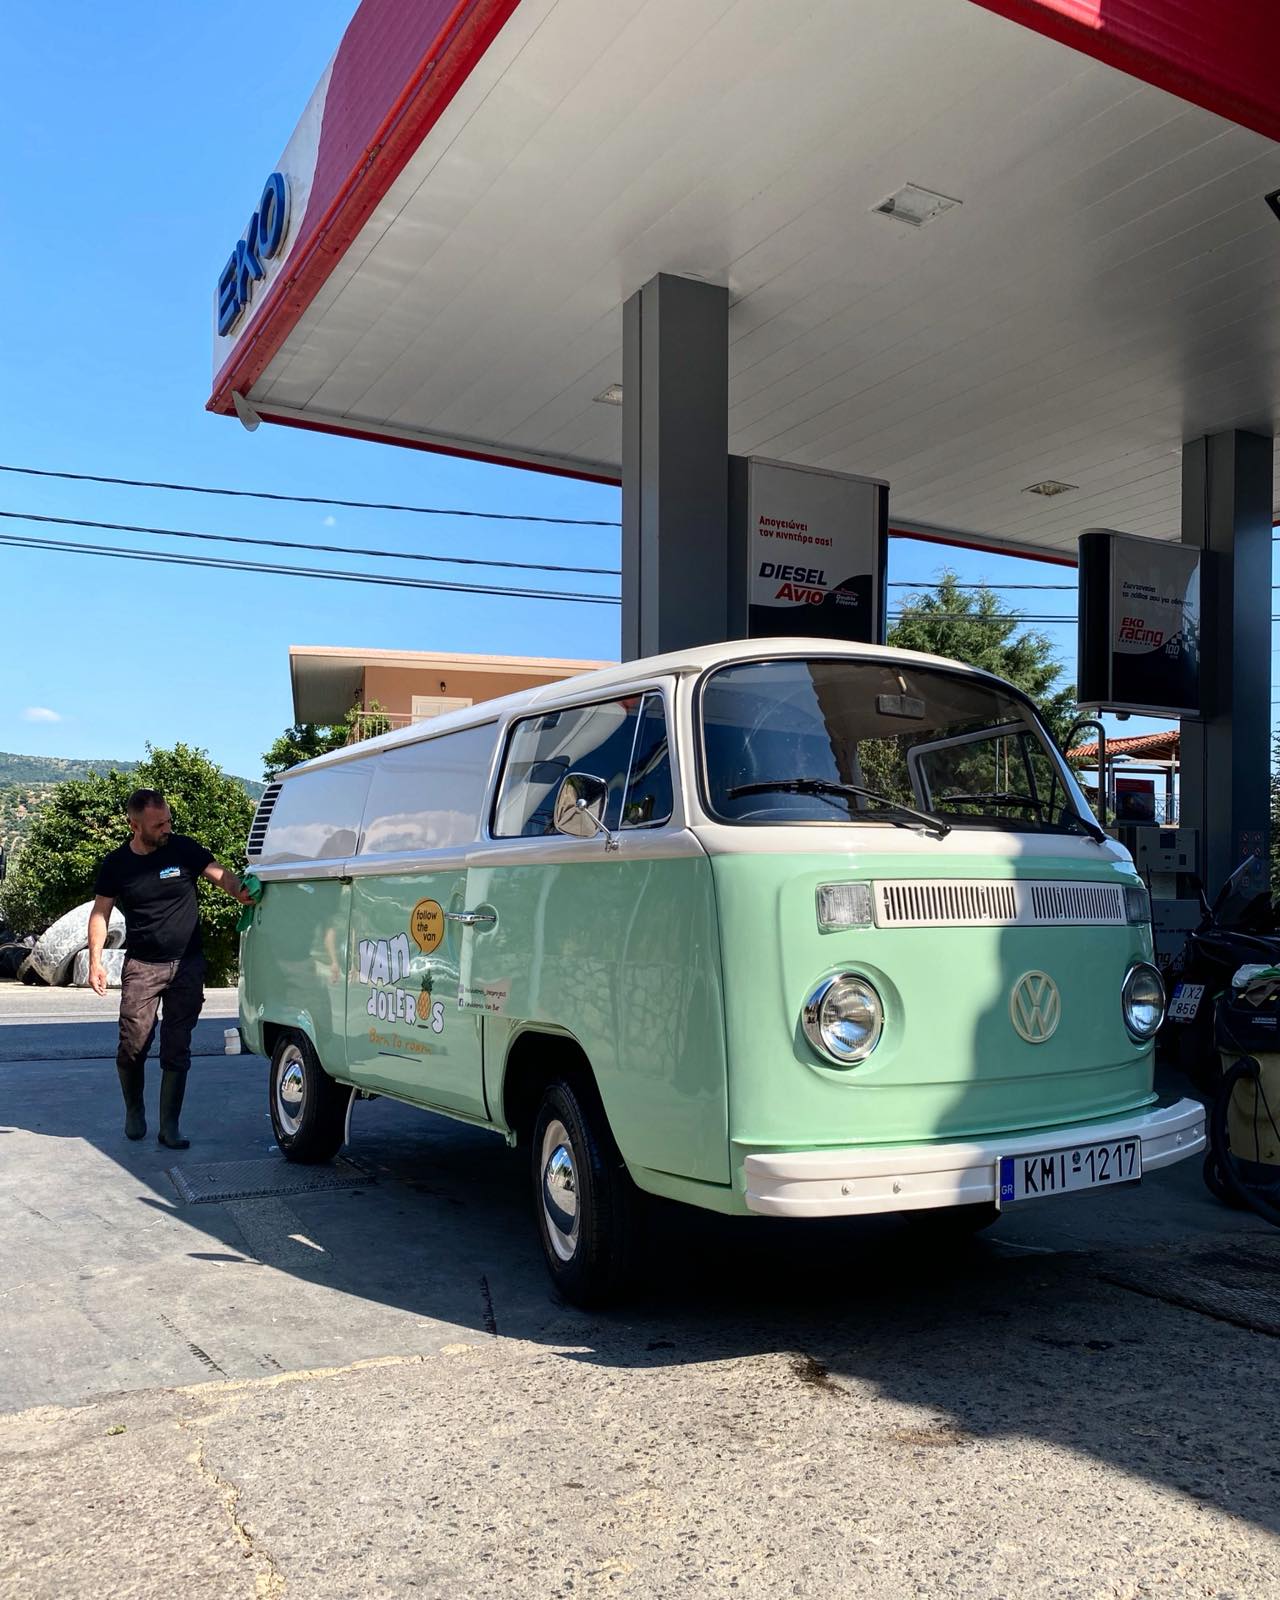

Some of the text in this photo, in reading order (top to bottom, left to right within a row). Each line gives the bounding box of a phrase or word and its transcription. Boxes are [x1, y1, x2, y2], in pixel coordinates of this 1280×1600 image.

[218, 172, 287, 337] EKO
[759, 515, 808, 532] Απογειώνει
[759, 528, 774, 538] τον
[776, 530, 813, 545] κινητήρα
[759, 562, 827, 586] DIESEL
[1121, 617, 1144, 628] EKO
[1119, 627, 1164, 647] racing
[1165, 643, 1180, 655] 100
[416, 909, 437, 921] follow
[417, 922, 428, 933] the
[423, 933, 436, 942] van
[1011, 971, 1060, 1042] VW
[1001, 1185, 1014, 1195] GR
